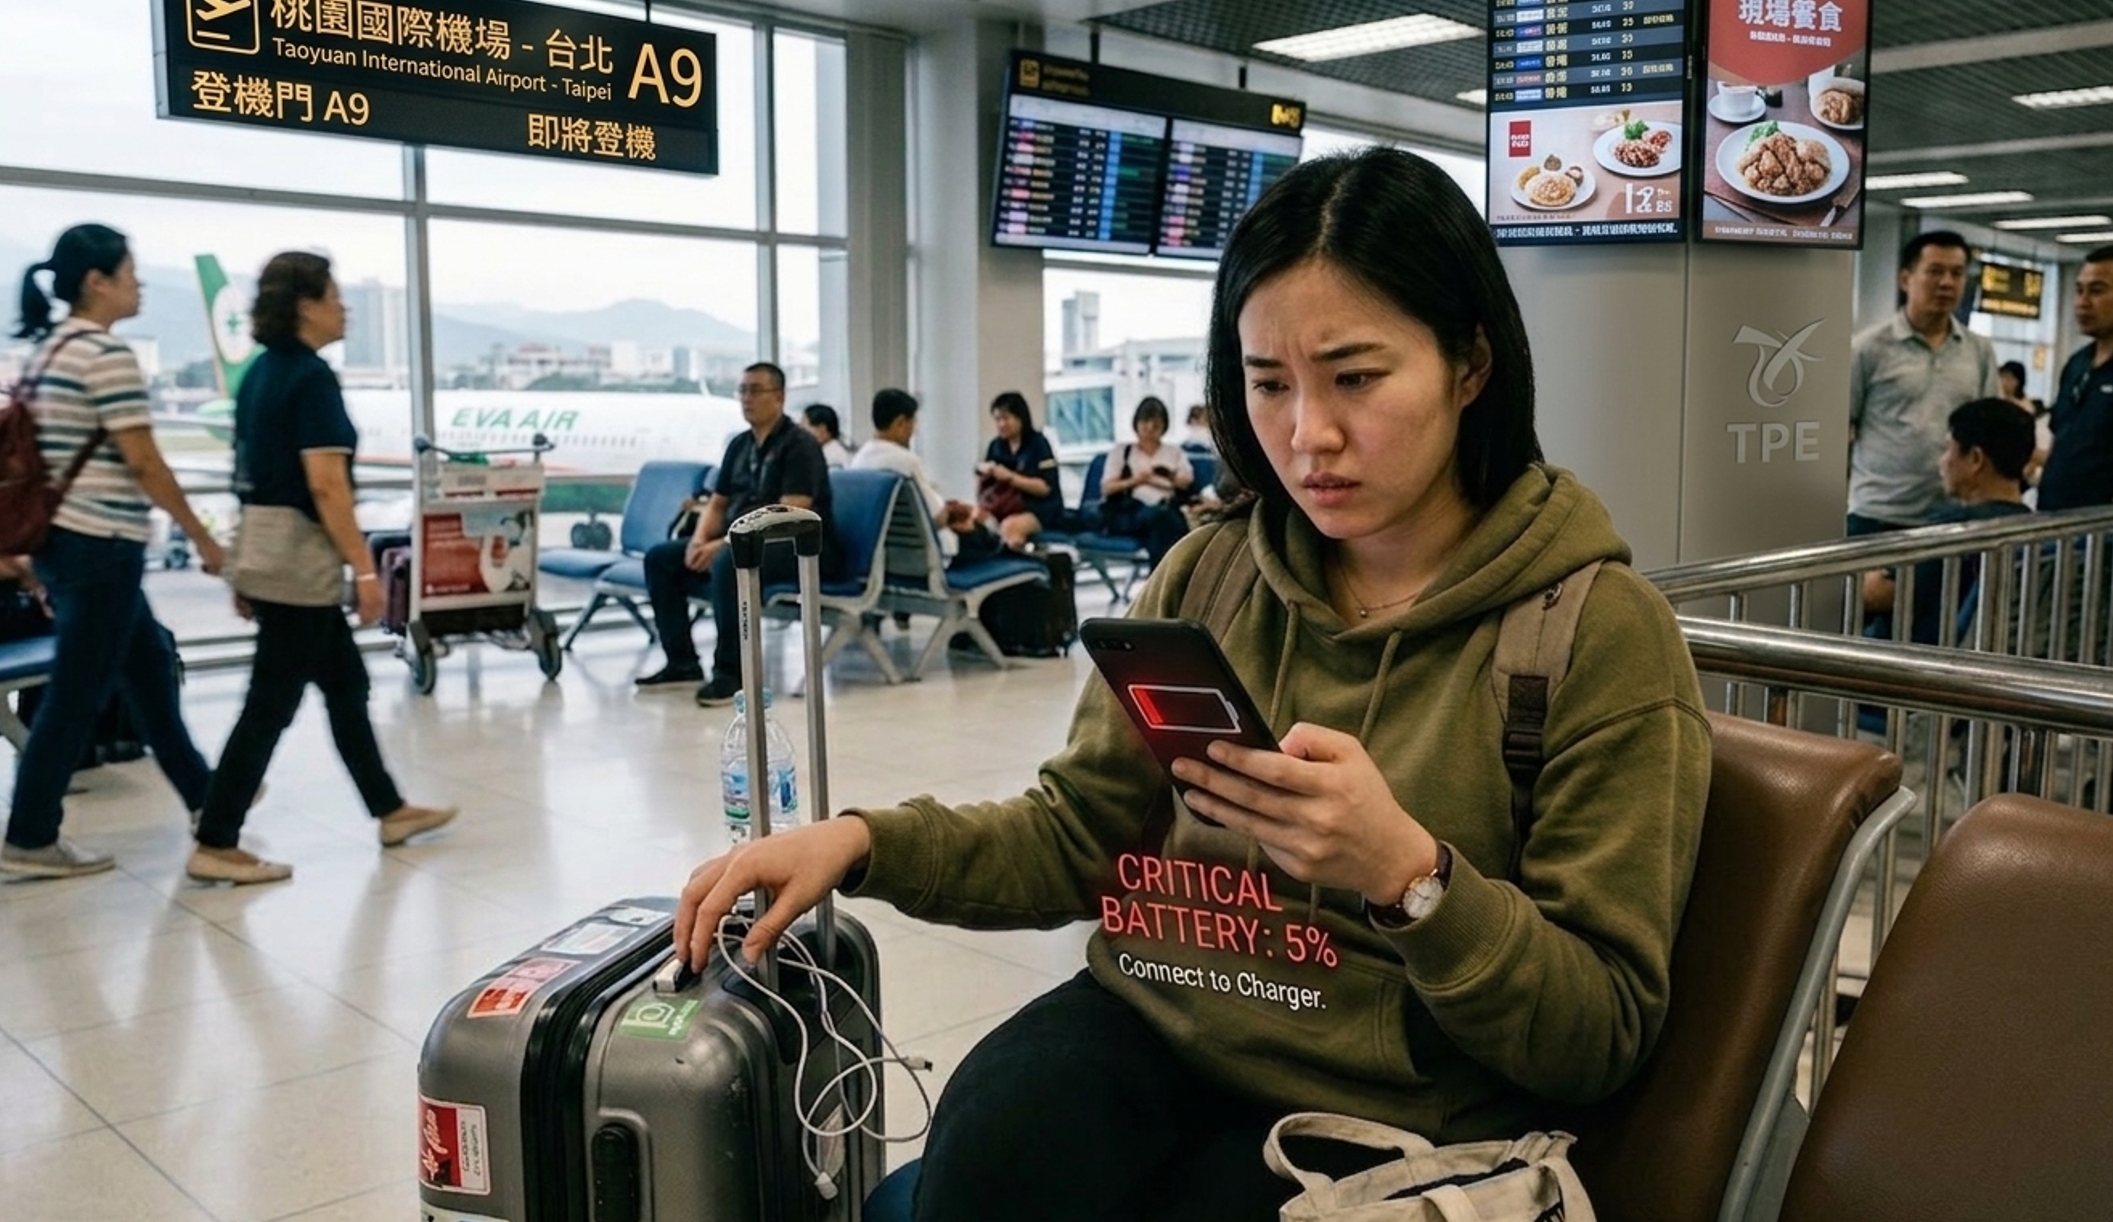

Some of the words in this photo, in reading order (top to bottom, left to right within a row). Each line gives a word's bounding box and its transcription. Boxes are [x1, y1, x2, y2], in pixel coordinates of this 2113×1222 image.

[270, 0, 512, 61] 桃園國際機場
[546, 28, 614, 75] 台北
[190, 70, 314, 123] 登機門
[323, 90, 370, 126] A9
[272, 37, 356, 66] Taoyuan
[362, 50, 481, 84] International
[485, 68, 546, 92] Airport
[562, 78, 612, 103] Taipei
[627, 43, 703, 108] A9
[527, 113, 657, 161] 即將登機
[451, 407, 512, 429] EVA
[518, 409, 580, 432] AIR
[1726, 421, 1820, 464] TPE
